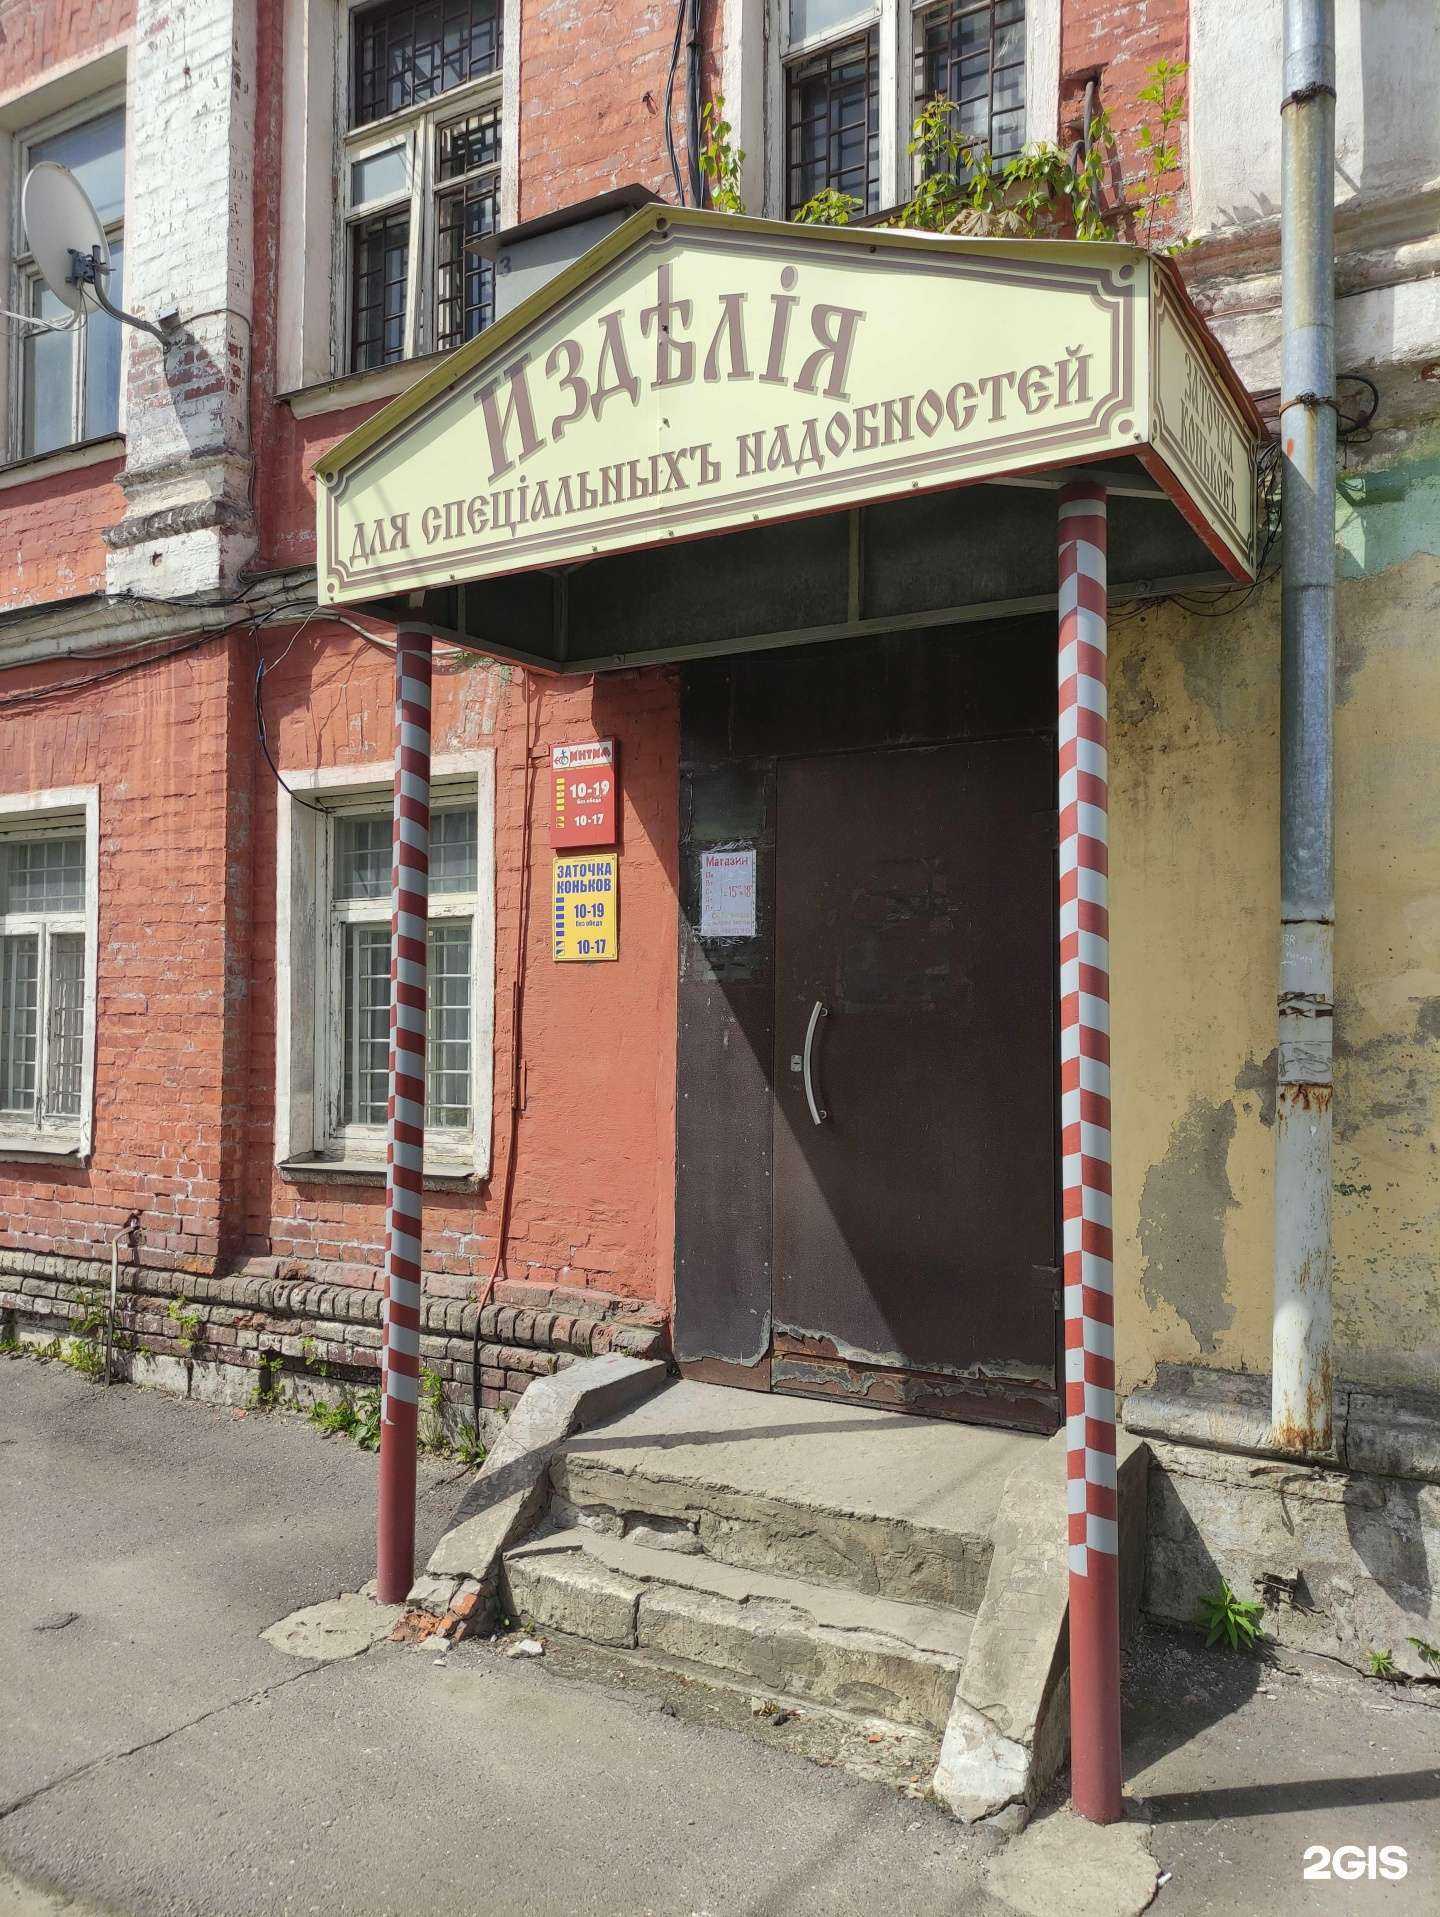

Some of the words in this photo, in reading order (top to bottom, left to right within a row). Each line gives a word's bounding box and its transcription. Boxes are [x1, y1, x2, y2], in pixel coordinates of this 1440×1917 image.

[1184, 351, 1234, 473] ЗАТОЧКА
[349, 512, 410, 567] ДЛЯ
[735, 344, 1095, 479] НАДОБНОСТЕЙ
[1180, 397, 1238, 524] КОНЬКОВЪ
[569, 780, 610, 798] 10-19
[574, 813, 605, 827] 10-17
[706, 855, 749, 868] Магазин
[557, 862, 612, 878] ЗАТОЧКА
[557, 878, 611, 894] КОНЬКОВ
[574, 903, 605, 919] 10-19
[577, 939, 606, 954] 10-17
